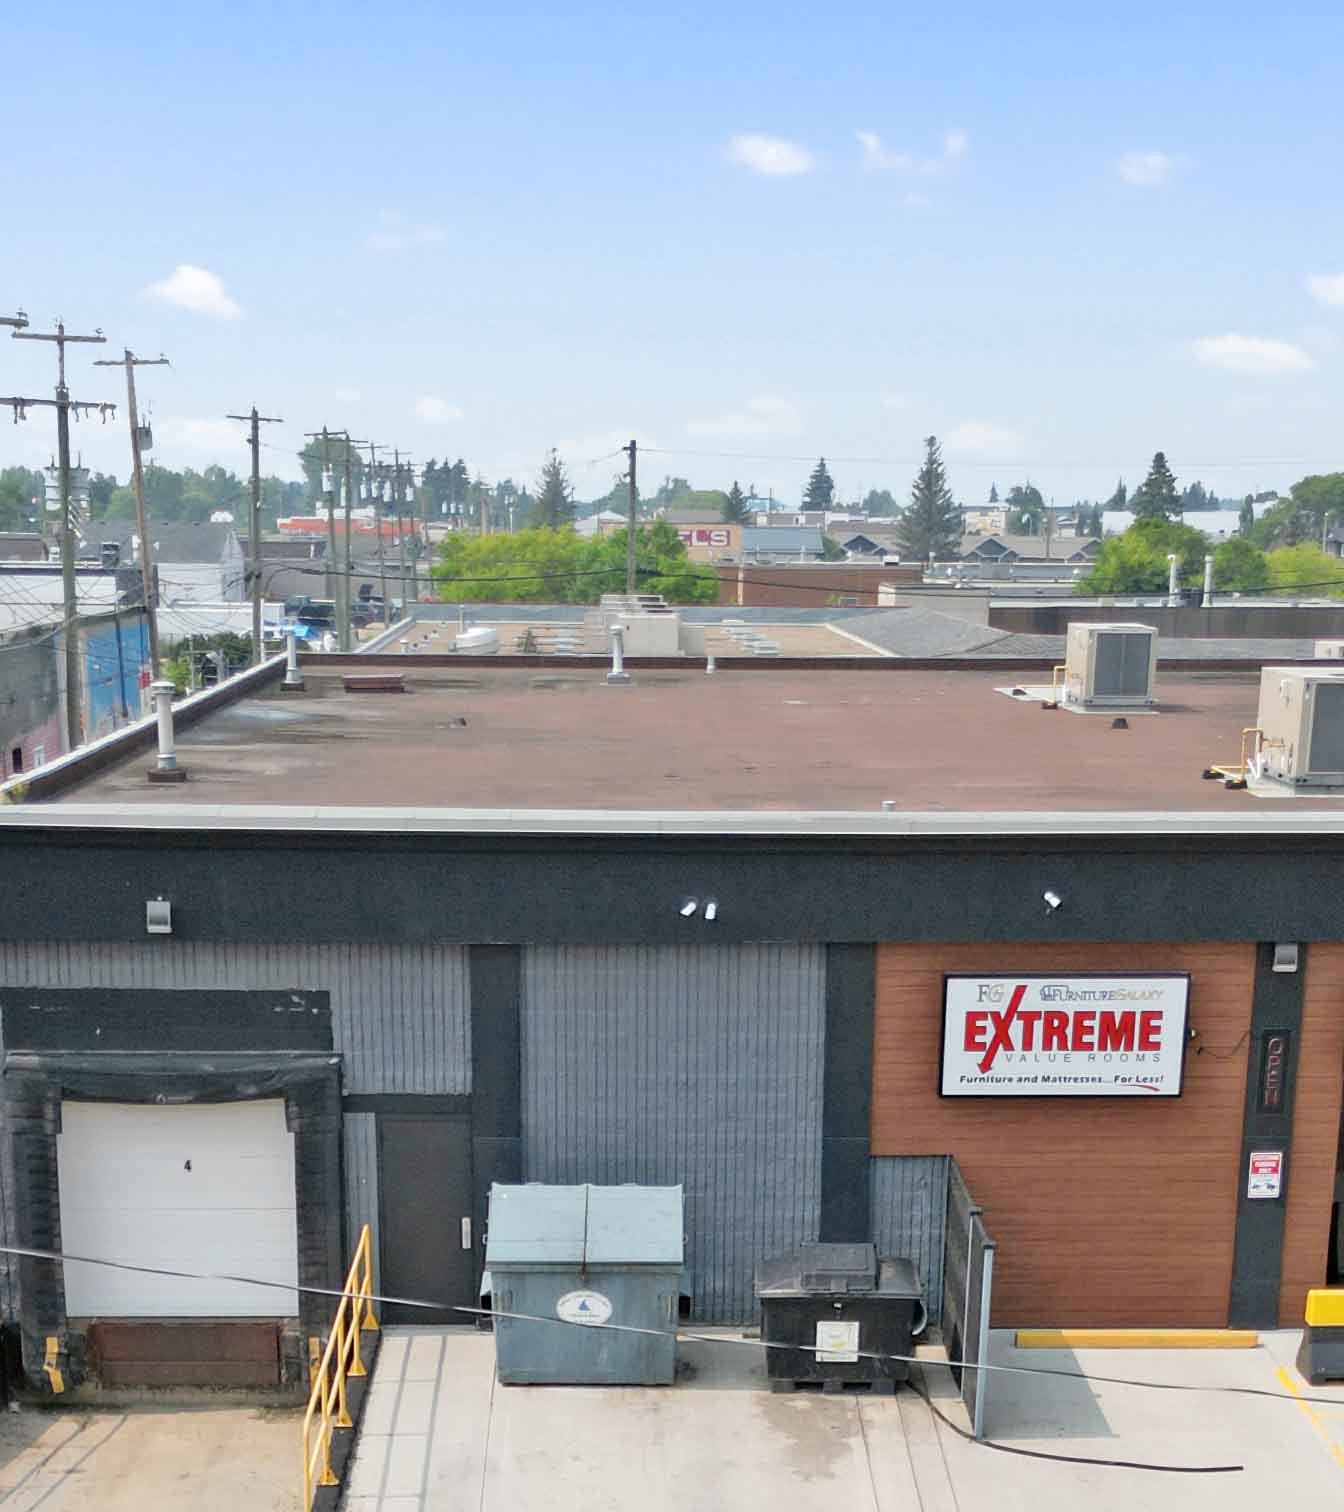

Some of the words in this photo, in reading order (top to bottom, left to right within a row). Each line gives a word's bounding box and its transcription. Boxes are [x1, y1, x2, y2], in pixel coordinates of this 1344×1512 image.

[964, 1011, 1163, 1052] EXTREME
[1005, 1053, 1072, 1063] VALUE
[1087, 1053, 1161, 1063] ROOMS
[959, 1075, 1013, 1083] Furniture
[1017, 1075, 1038, 1083] and
[184, 1159, 192, 1172] 4
